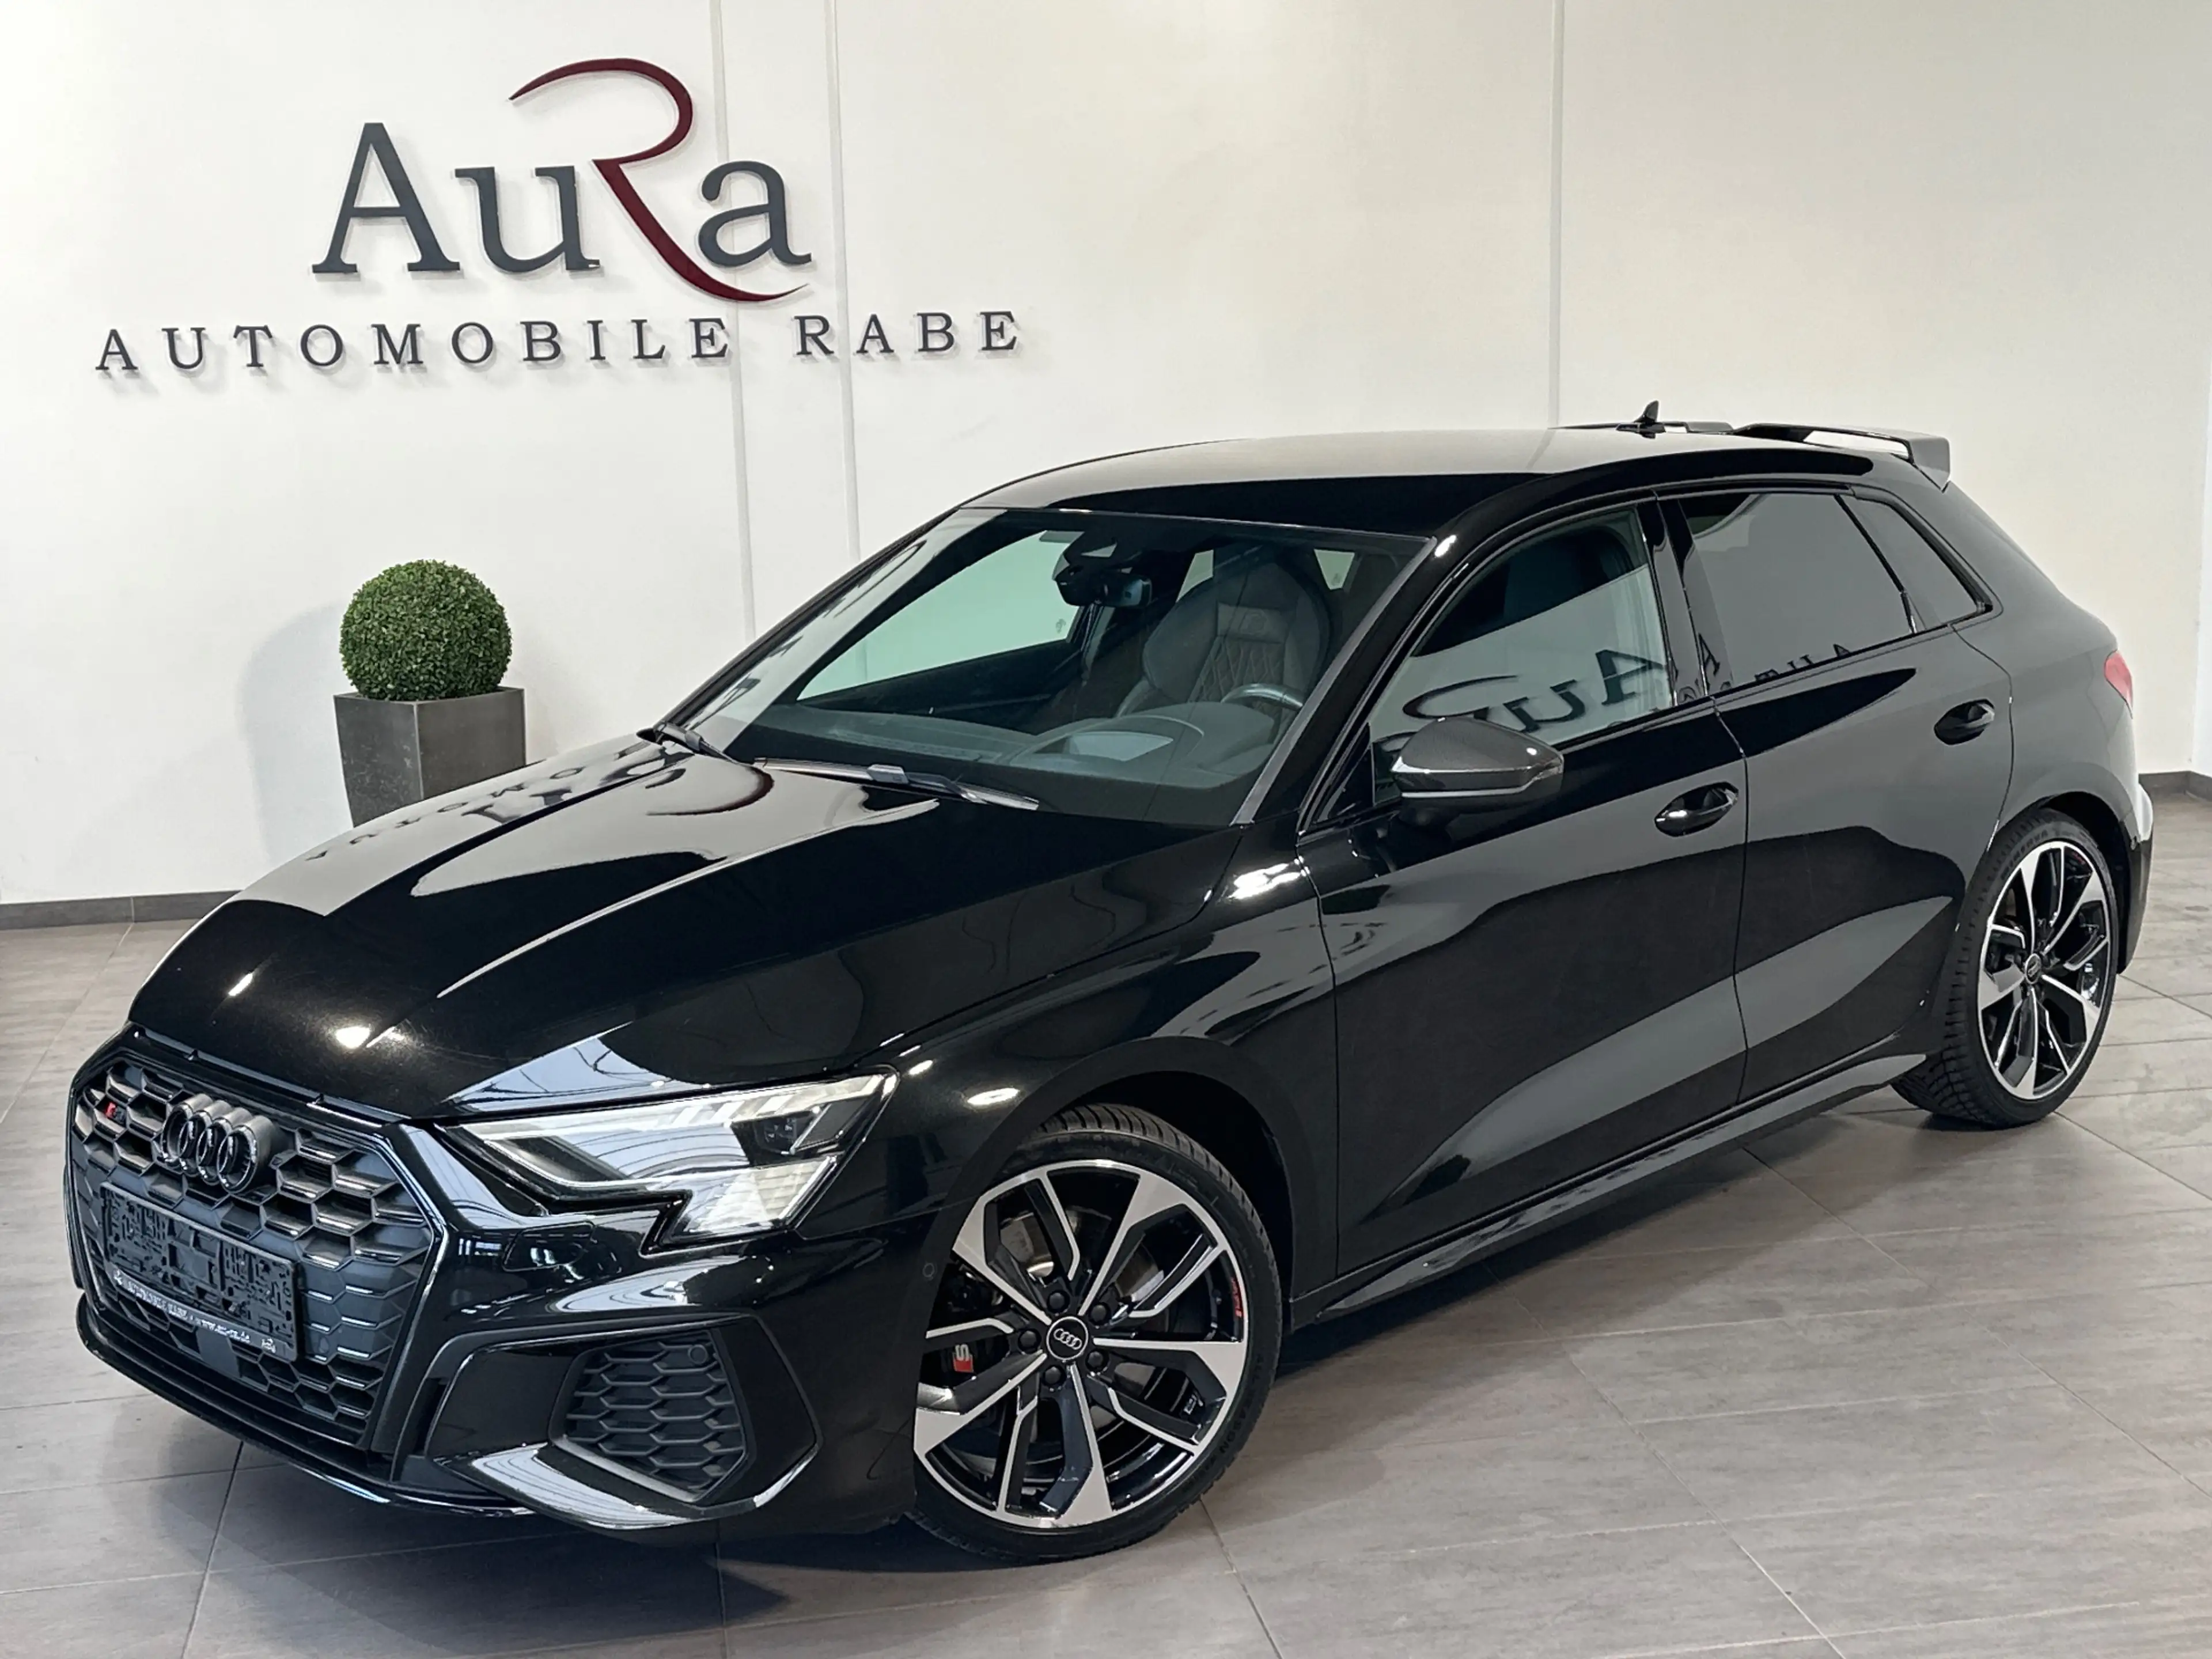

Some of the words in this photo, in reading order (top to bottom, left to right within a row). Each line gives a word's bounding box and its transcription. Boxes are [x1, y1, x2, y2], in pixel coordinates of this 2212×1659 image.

[311, 58, 812, 304] AuRa
[94, 317, 729, 372] AUTOMOBILE
[793, 310, 1018, 357] RABE
